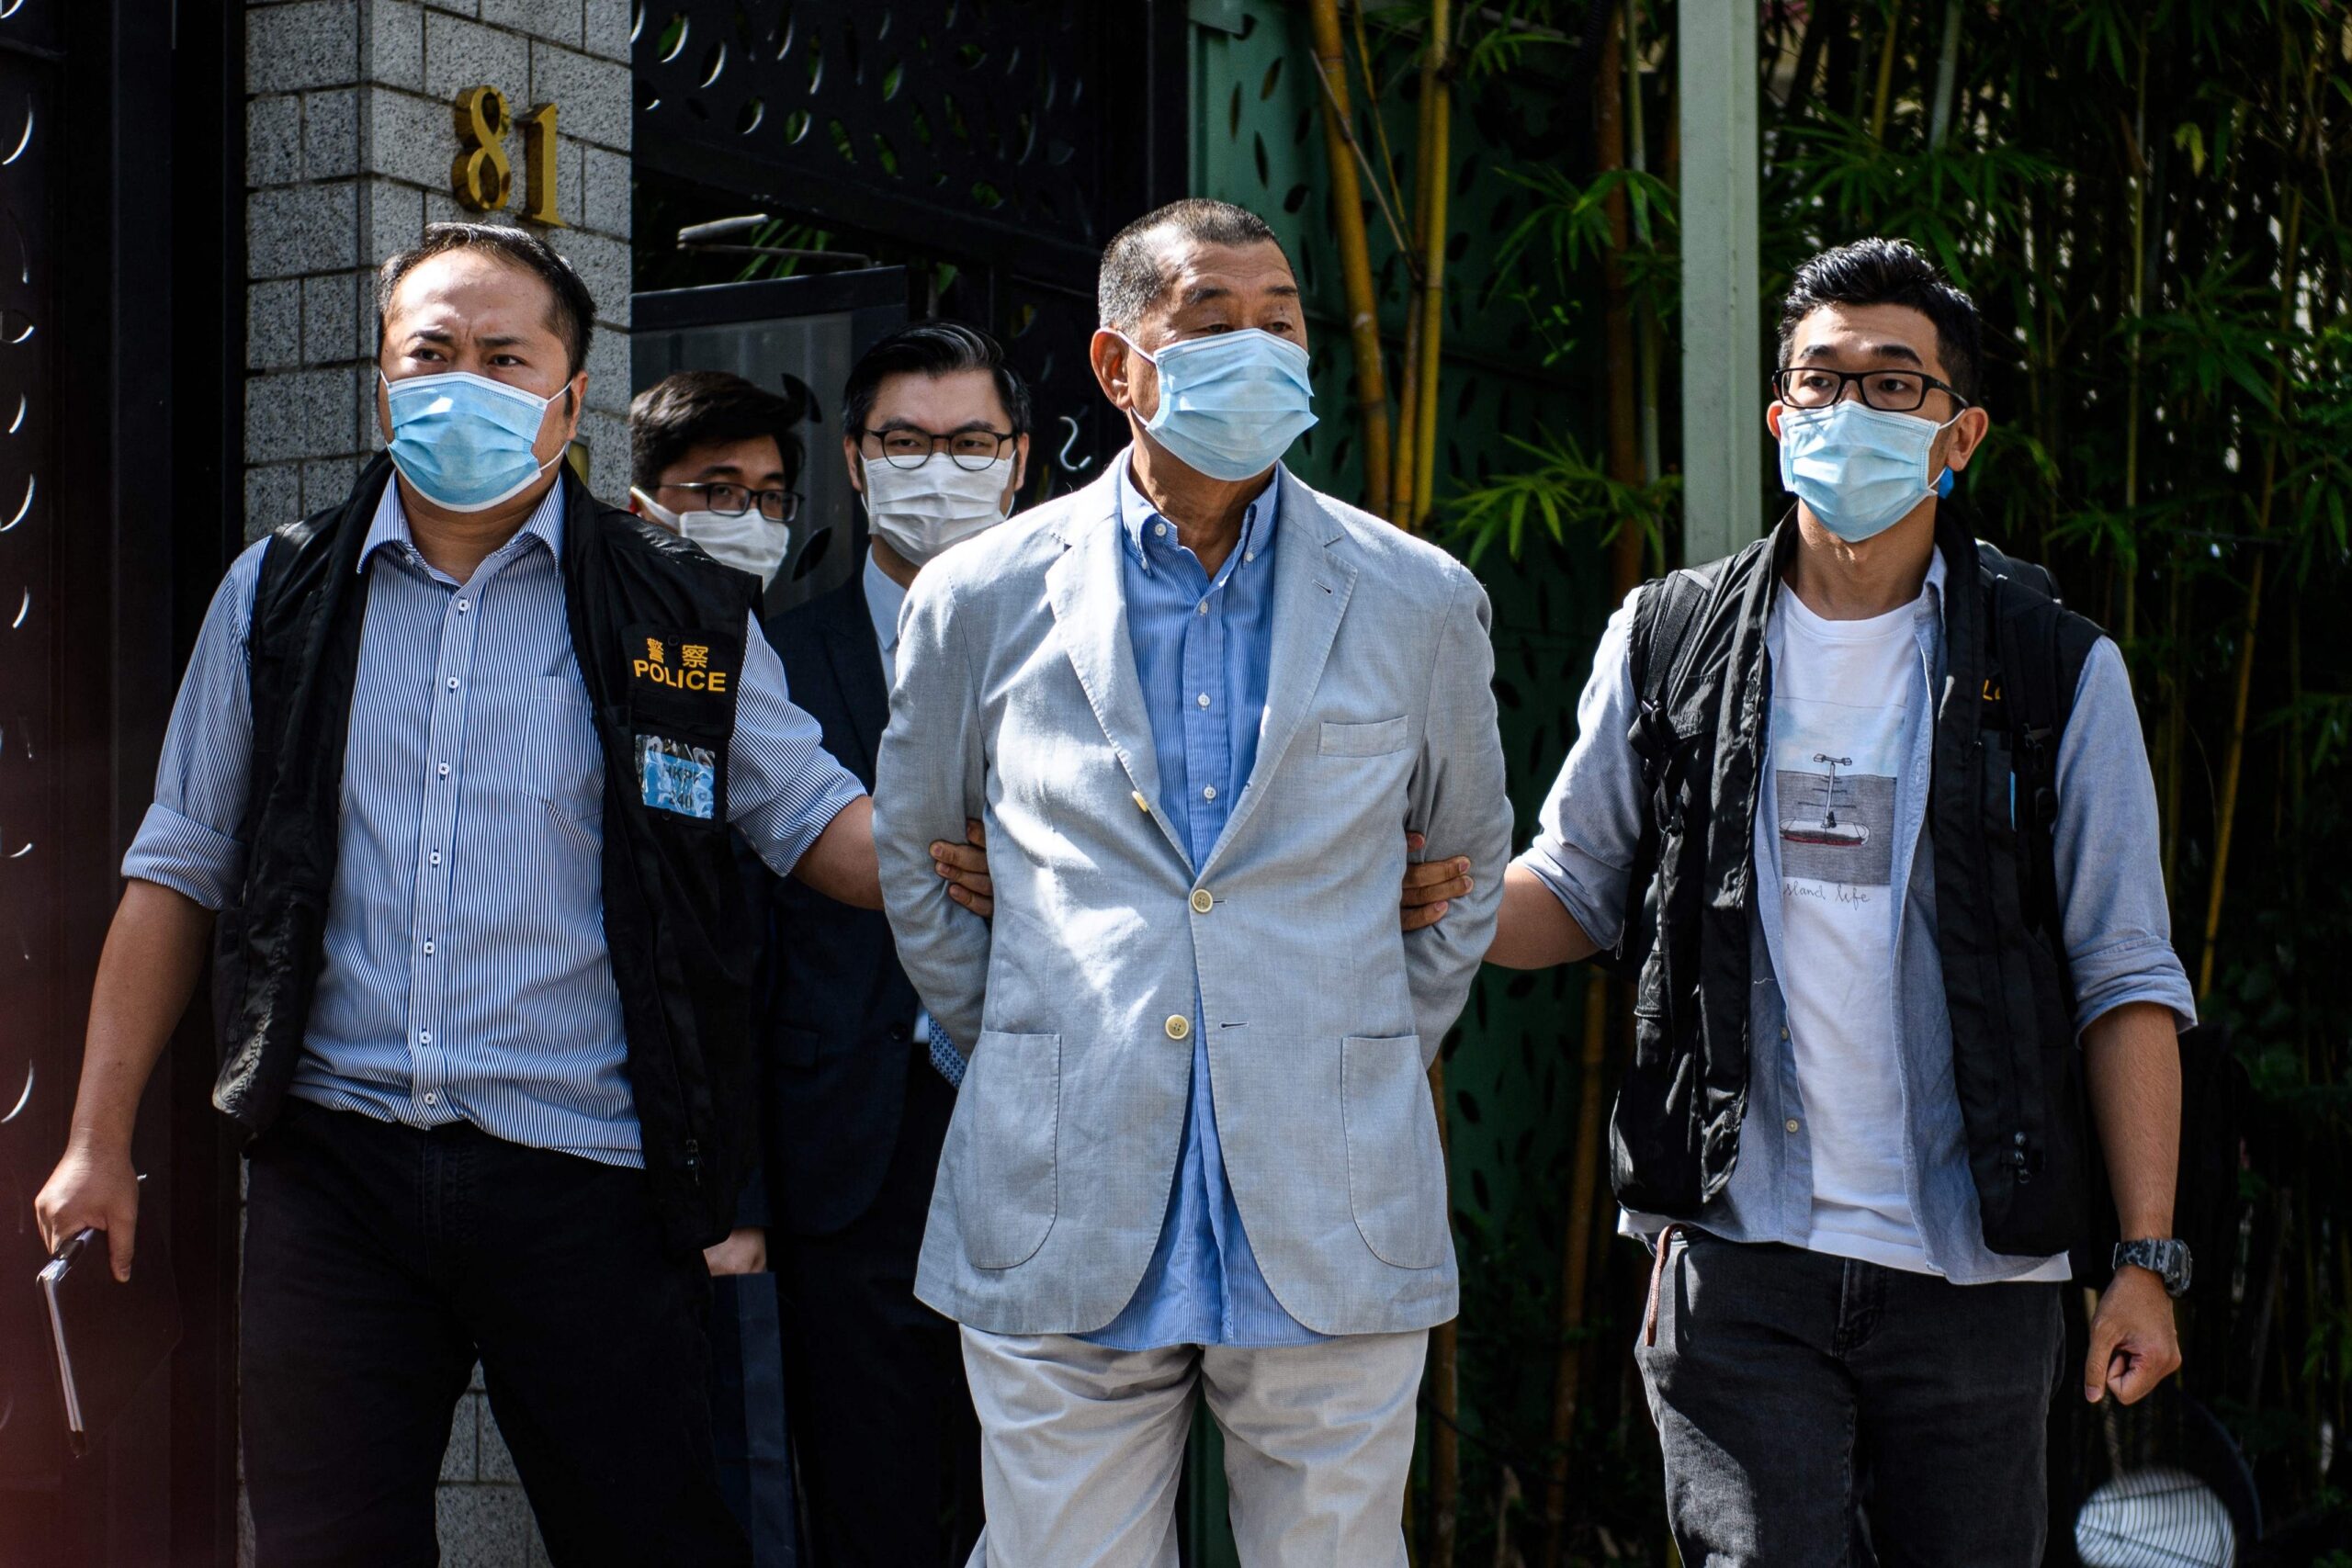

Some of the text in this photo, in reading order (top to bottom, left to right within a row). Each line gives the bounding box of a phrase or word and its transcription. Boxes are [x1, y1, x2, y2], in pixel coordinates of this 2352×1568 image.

[453, 85, 567, 228] 81
[647, 637, 708, 669] 警察
[633, 660, 727, 692] POLICE
[1782, 881, 1871, 911] sland life
